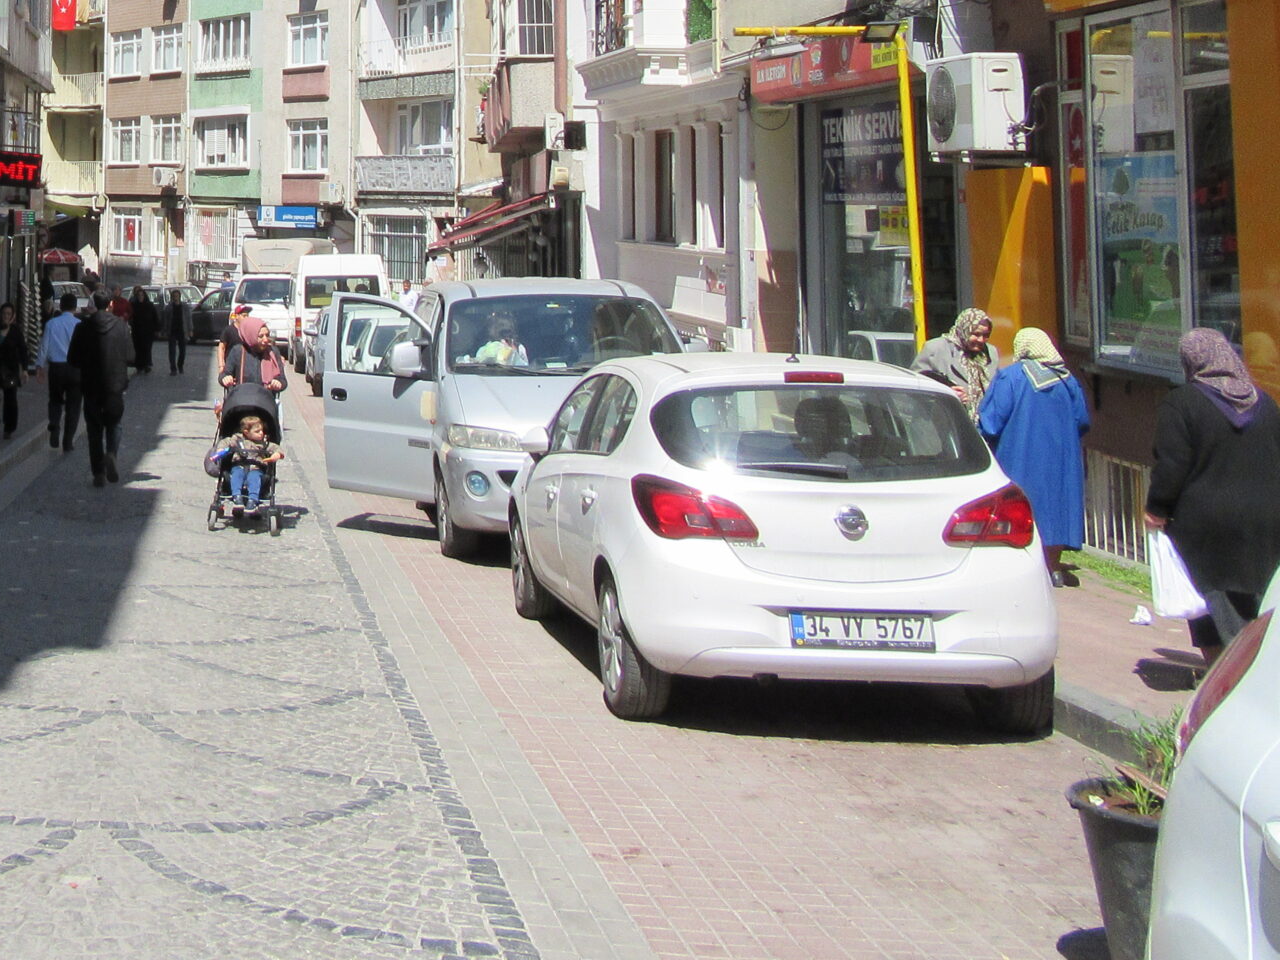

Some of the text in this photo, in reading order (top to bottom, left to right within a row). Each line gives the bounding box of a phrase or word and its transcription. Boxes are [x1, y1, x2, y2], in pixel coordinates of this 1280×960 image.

[823, 104, 903, 144] TEKNİK SERVİ
[806, 615, 925, 640] 34 VY 5767
